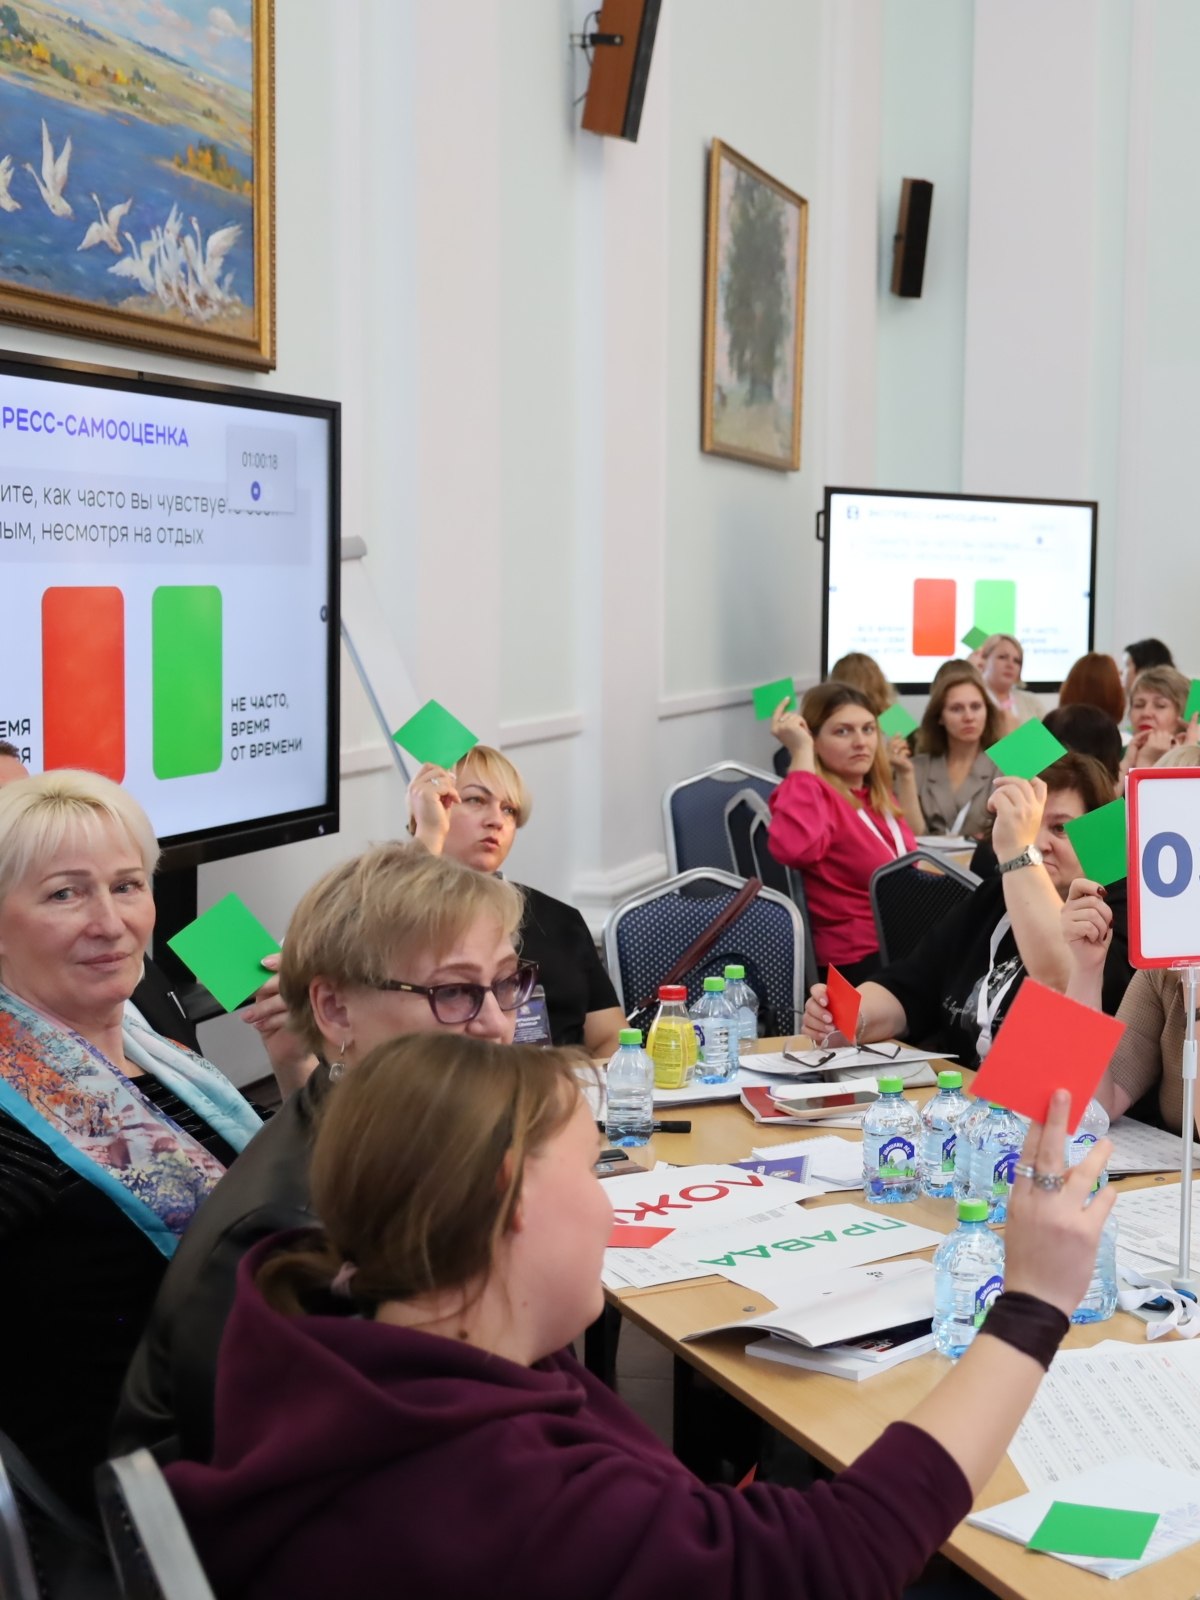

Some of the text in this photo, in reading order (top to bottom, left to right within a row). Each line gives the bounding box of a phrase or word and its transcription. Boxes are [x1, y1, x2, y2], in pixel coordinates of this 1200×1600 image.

[2, 406, 189, 448] РЕСС-САМООЦЕНКА
[241, 451, 279, 470] 01:00:18
[43, 486, 72, 506] как
[77, 489, 126, 509] часто
[131, 492, 152, 510] вы
[157, 494, 241, 519] чувствуе
[0, 521, 204, 548] ым, несмотря на отдых
[231, 693, 289, 712] НЕ ЧАСТО,
[231, 718, 270, 737] ВРЕМЯ
[231, 738, 303, 761] ОТ ВРЕМЕНИ
[613, 1175, 764, 1224] ЛОЖ
[698, 1218, 908, 1267] ПРАВДА
